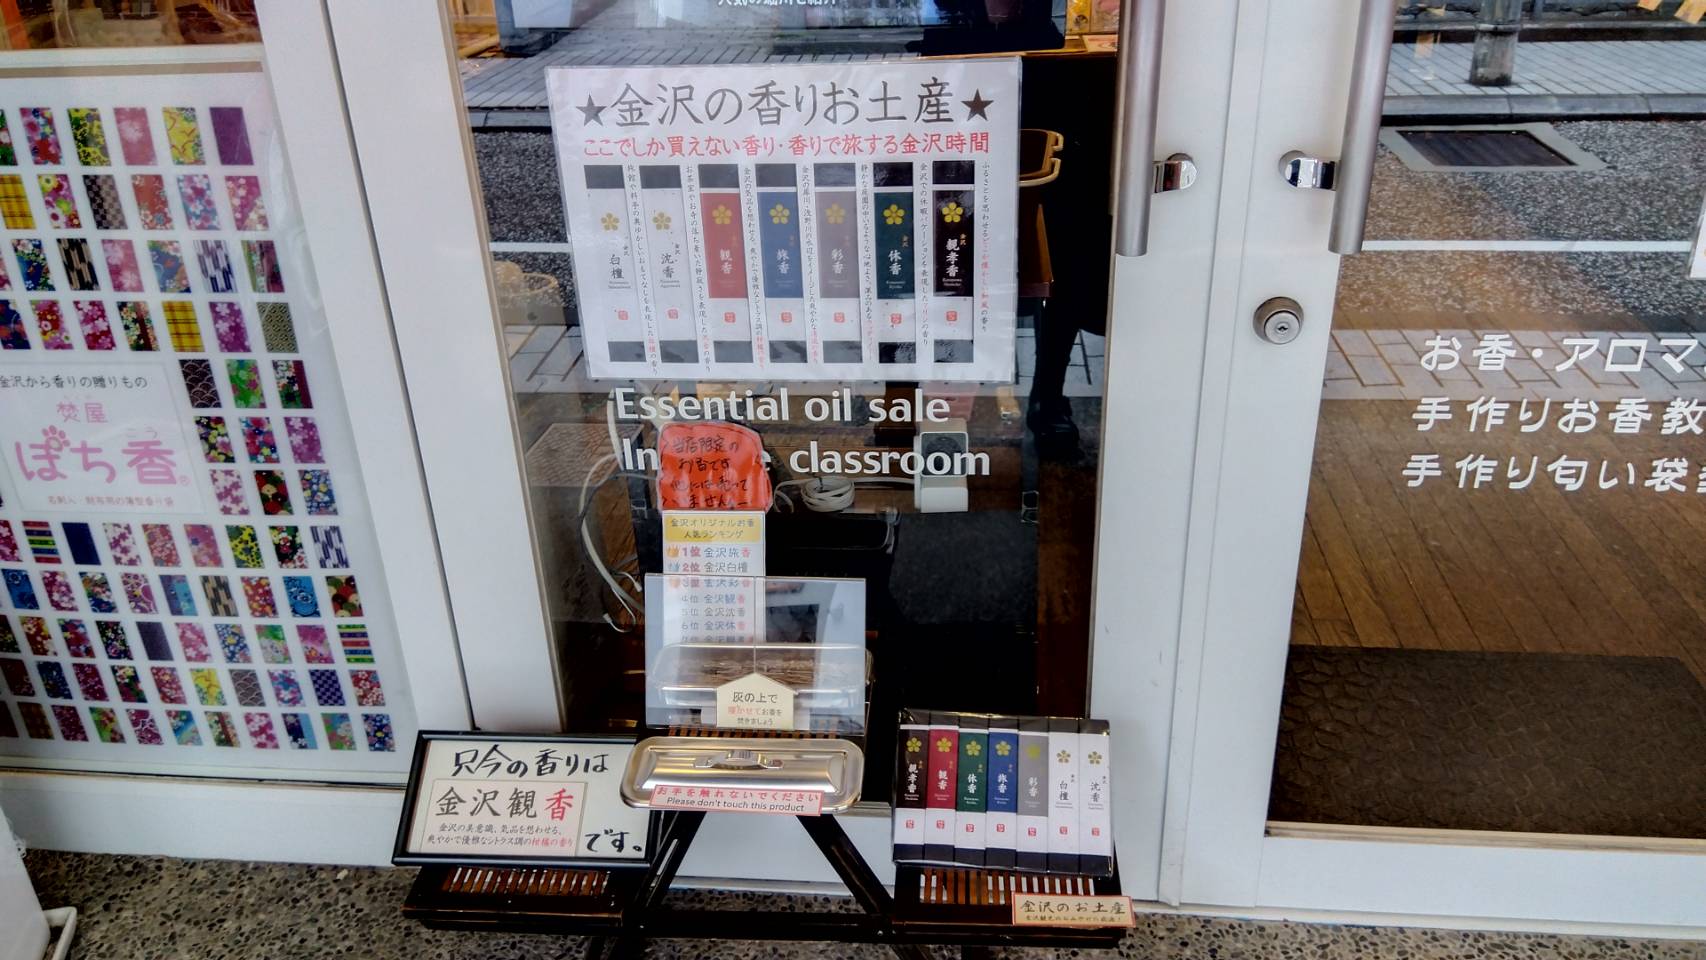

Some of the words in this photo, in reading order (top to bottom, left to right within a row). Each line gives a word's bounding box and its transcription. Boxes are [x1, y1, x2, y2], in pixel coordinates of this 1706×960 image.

[584, 132, 989, 157] ここでしか買えない香り・香りで旅する金沢時間
[1420, 334, 1706, 373] お香・アロマ
[0, 375, 147, 388] 金沢から香りの贈りもの
[57, 402, 108, 423] 焚屋
[615, 387, 789, 421] Essential
[804, 388, 851, 422] oil
[869, 389, 950, 422] sale
[1412, 396, 1706, 434] 手作りお香教
[15, 425, 177, 484] ぽち香
[673, 435, 739, 453] 当店限定の
[789, 440, 990, 475] classroom
[671, 518, 754, 527] 金沢オリジナルお香
[684, 530, 744, 539] 人気ランキング
[682, 562, 701, 572] 2位
[704, 562, 748, 573] 金沢白檀
[733, 691, 778, 703] 灰の上で
[451, 744, 609, 778] 只今の香りは
[435, 786, 574, 821] 金沢観香
[656, 787, 818, 802] お手を触れないでください
[667, 796, 697, 806] Please
[697, 799, 721, 807] don't
[723, 799, 748, 809] touch
[751, 800, 767, 810] this
[769, 802, 804, 812] product
[584, 829, 643, 853] です。
[1022, 900, 1126, 914] 金沢のお土産
